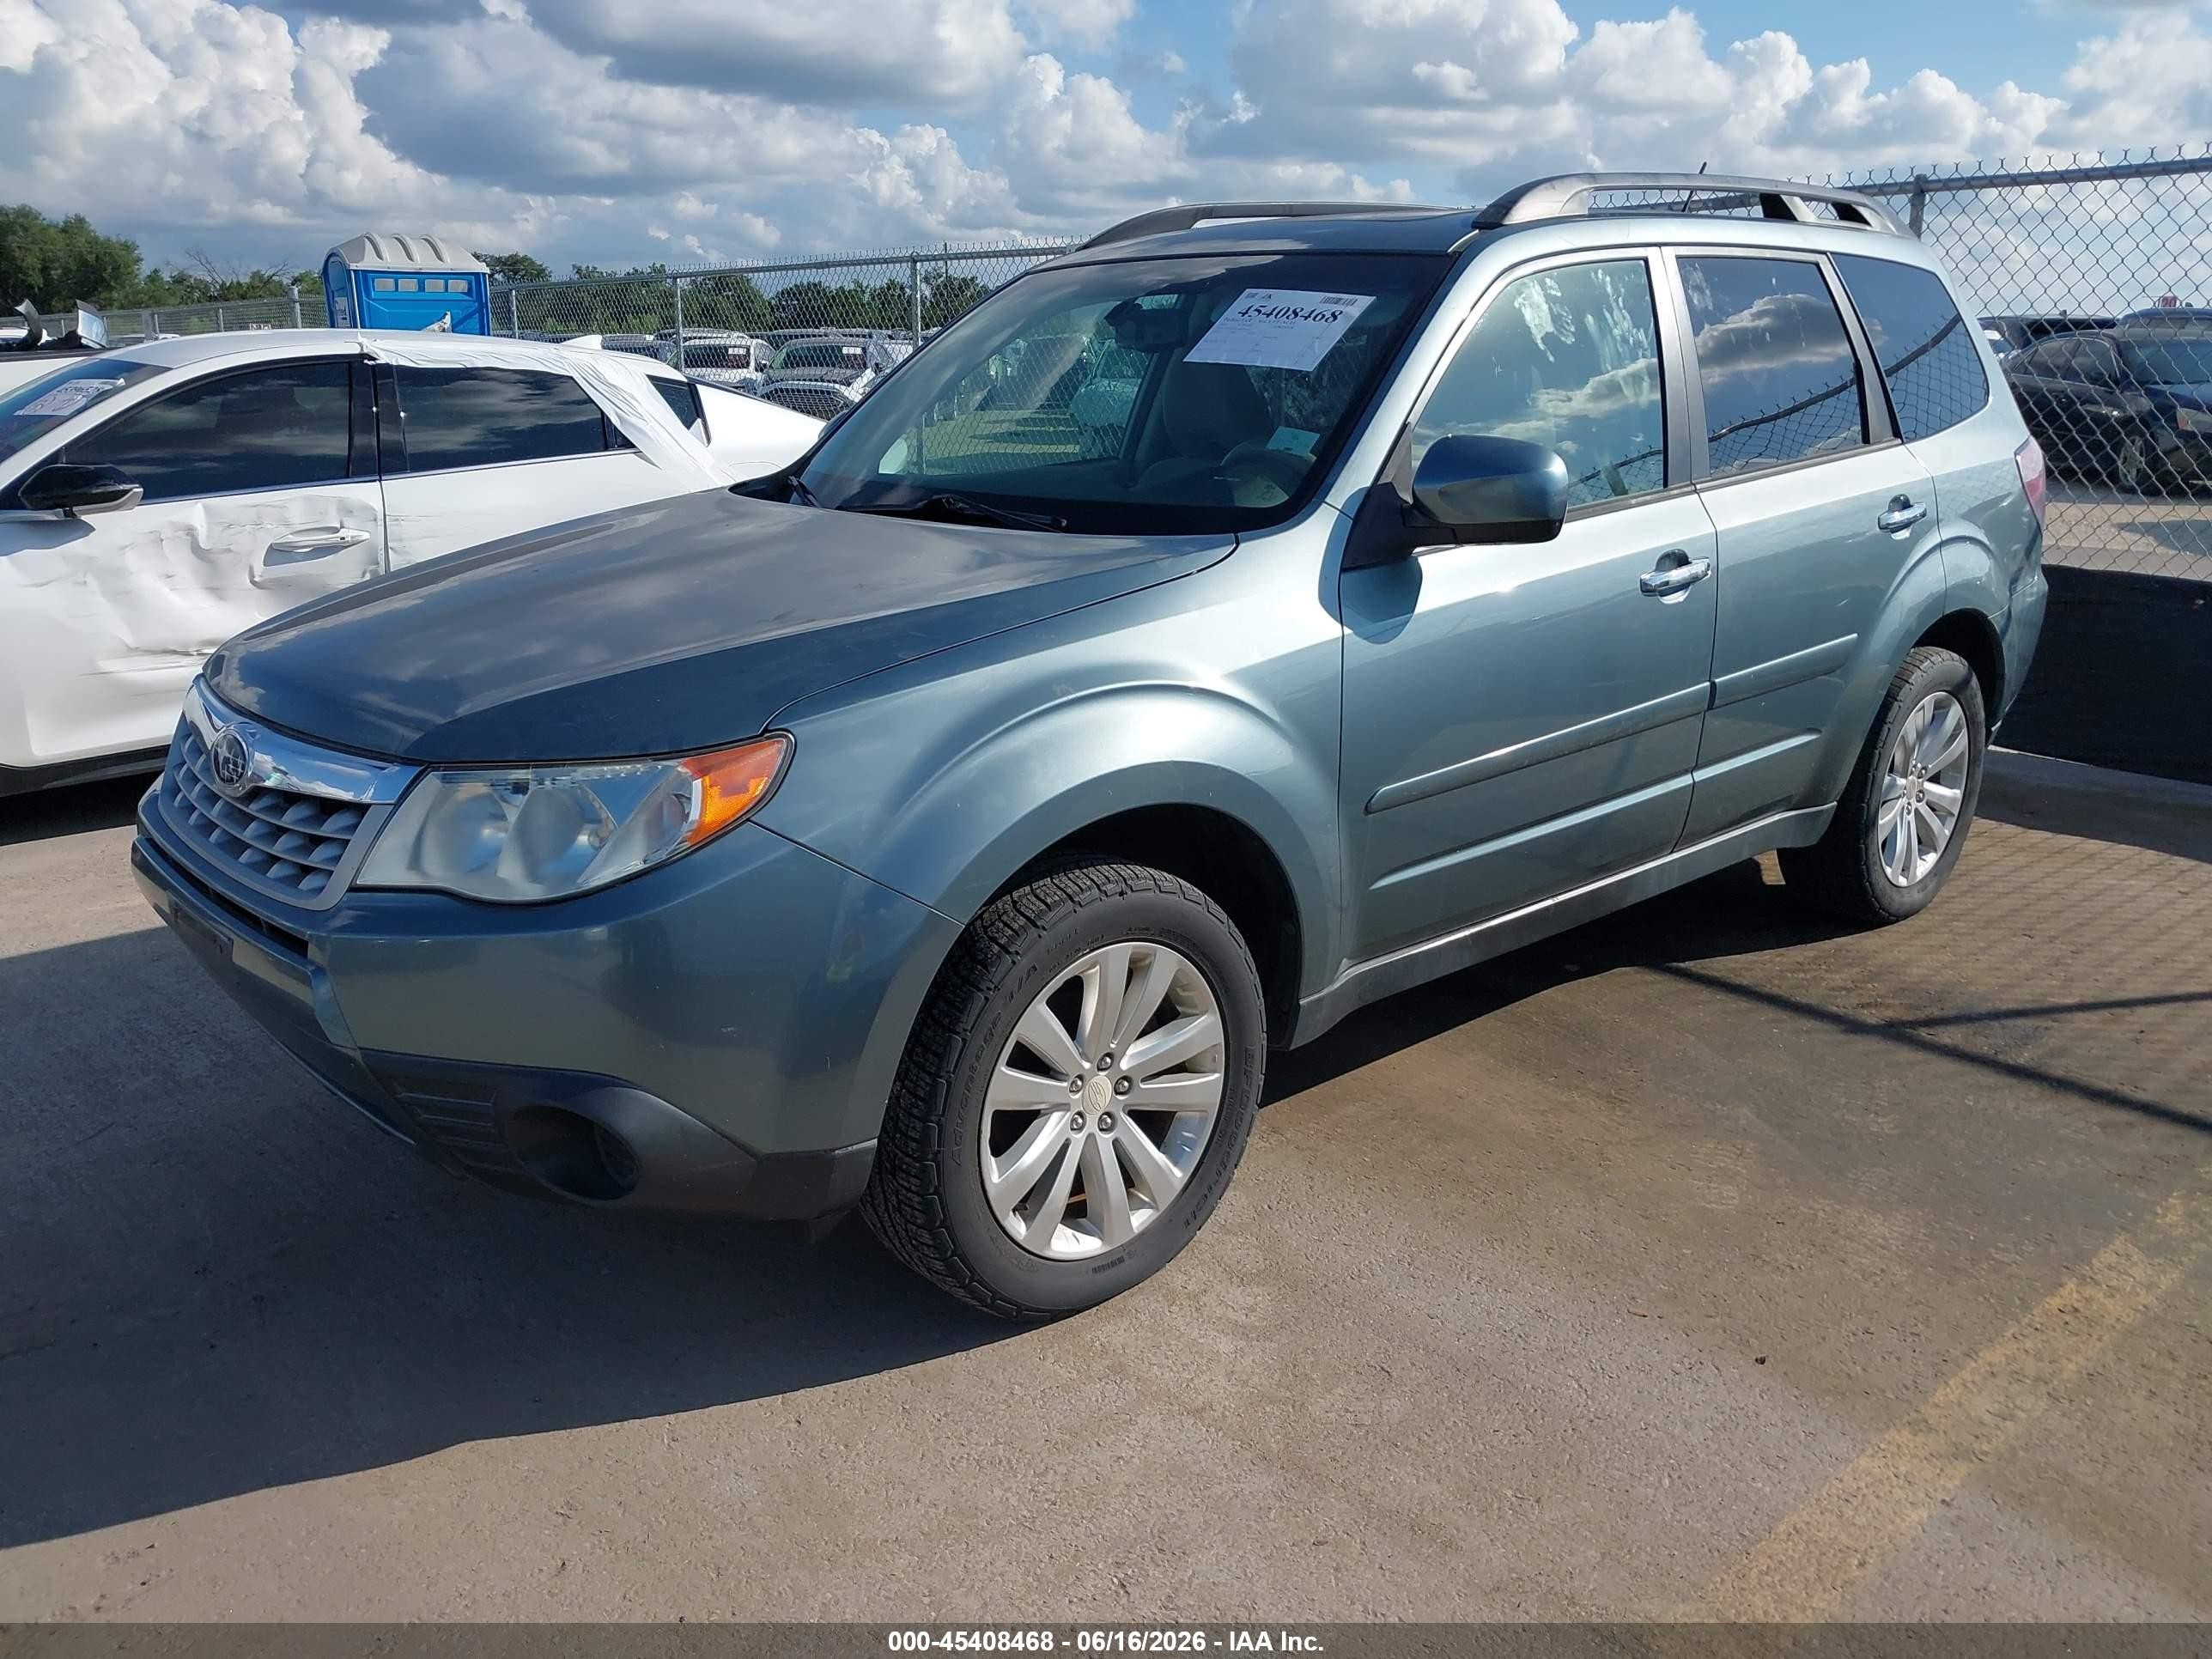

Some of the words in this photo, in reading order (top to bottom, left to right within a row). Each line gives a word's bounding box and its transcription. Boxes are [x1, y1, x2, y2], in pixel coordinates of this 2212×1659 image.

[1237, 304, 1344, 324] 45408468
[951, 1010, 1003, 1167] Advantage
[1182, 1044, 1256, 1230] BFGoodrich
